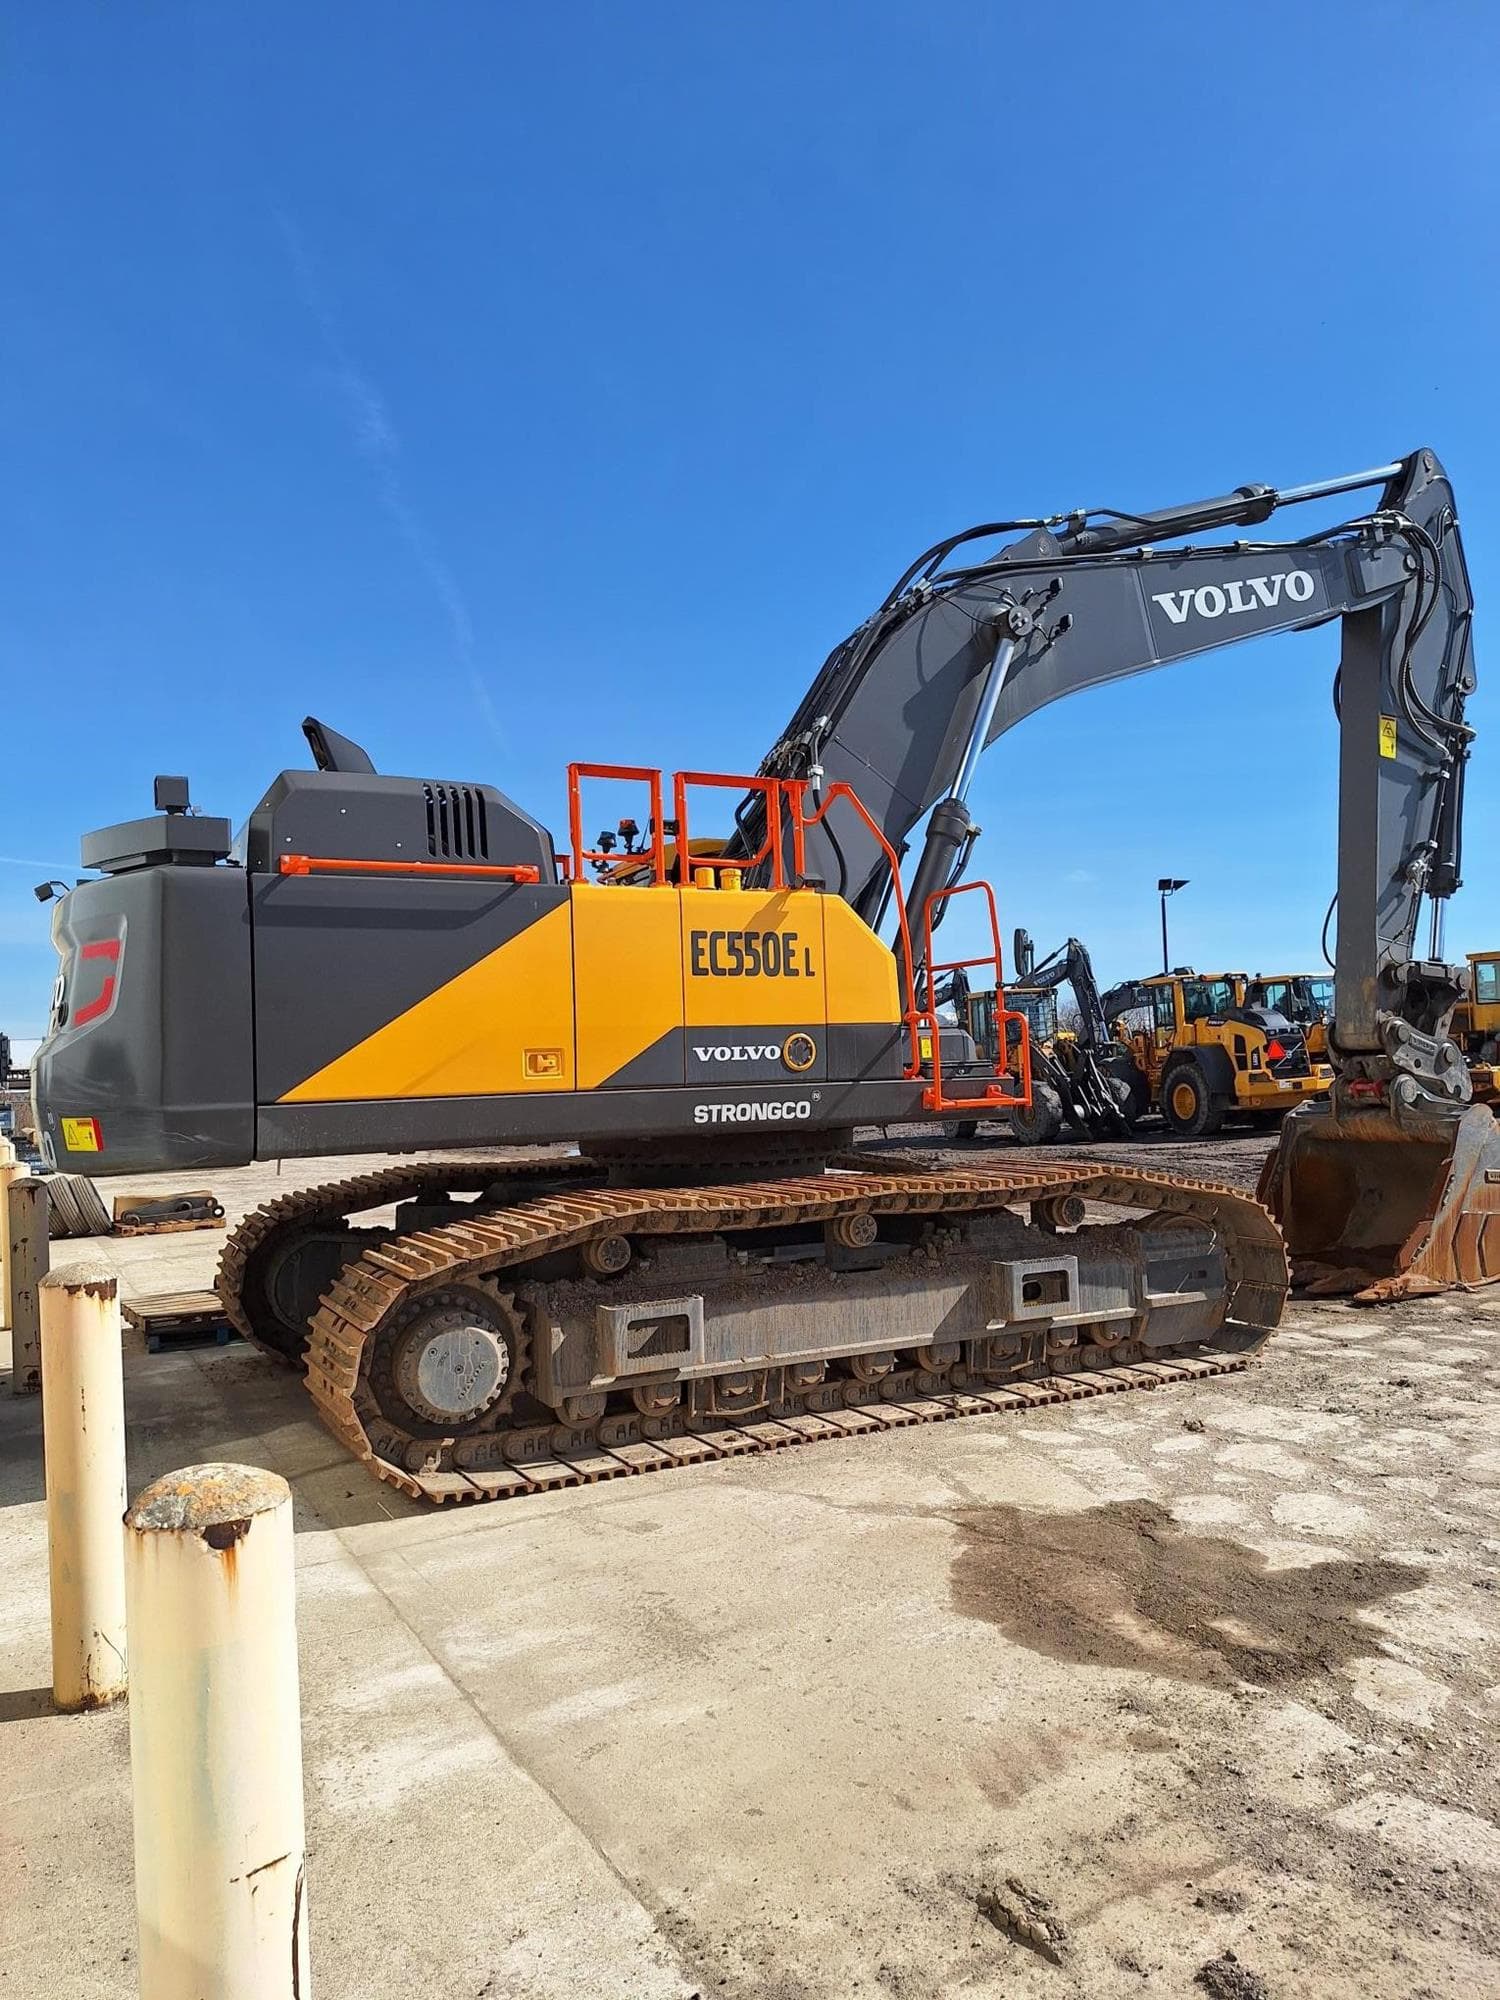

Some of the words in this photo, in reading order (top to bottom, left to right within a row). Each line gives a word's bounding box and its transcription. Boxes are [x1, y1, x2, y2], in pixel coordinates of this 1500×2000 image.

[1152, 570, 1315, 624] VOLVO
[691, 930, 799, 977] EC550E
[804, 947, 815, 977] L
[693, 1045, 781, 1062] VOLVO
[694, 1101, 811, 1124] STRONGCO
